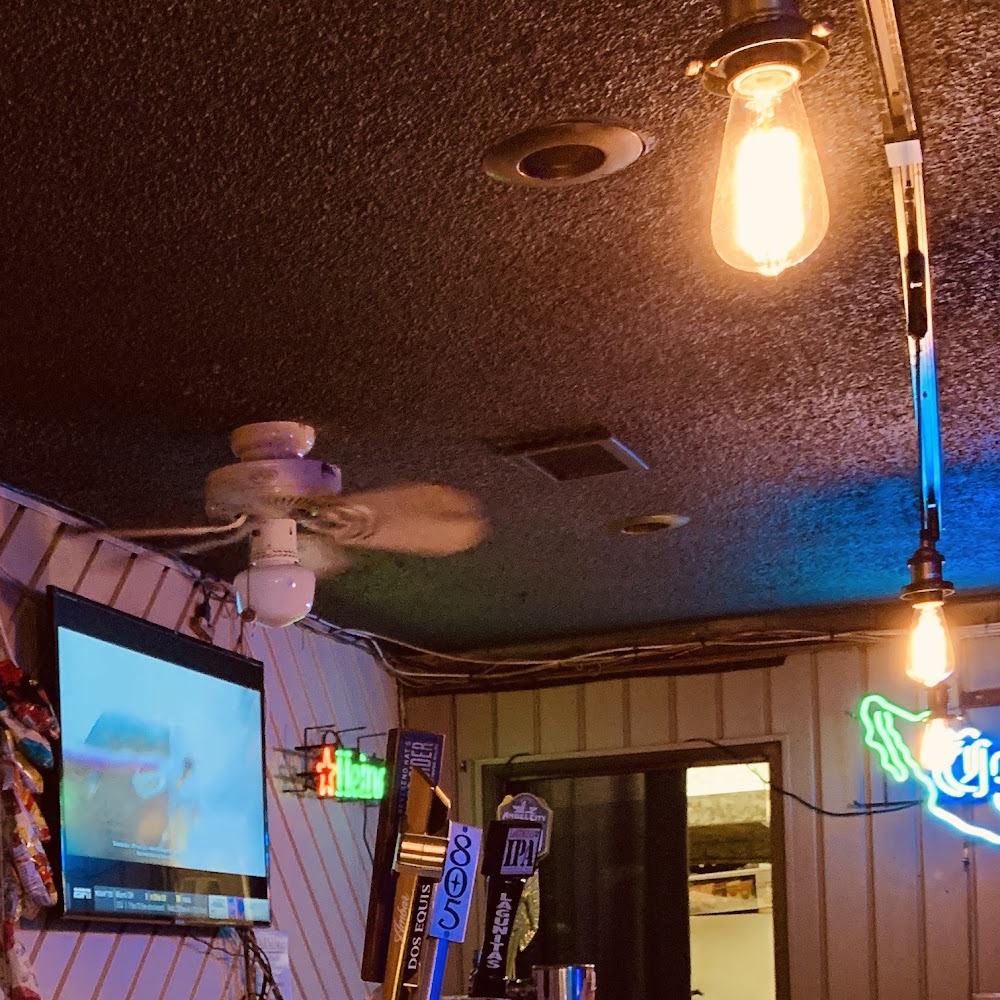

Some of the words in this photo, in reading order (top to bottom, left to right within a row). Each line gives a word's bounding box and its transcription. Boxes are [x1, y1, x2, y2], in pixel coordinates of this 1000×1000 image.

[503, 839, 534, 867] IPA
[407, 934, 423, 970] DOS
[415, 883, 431, 934] EQUIS
